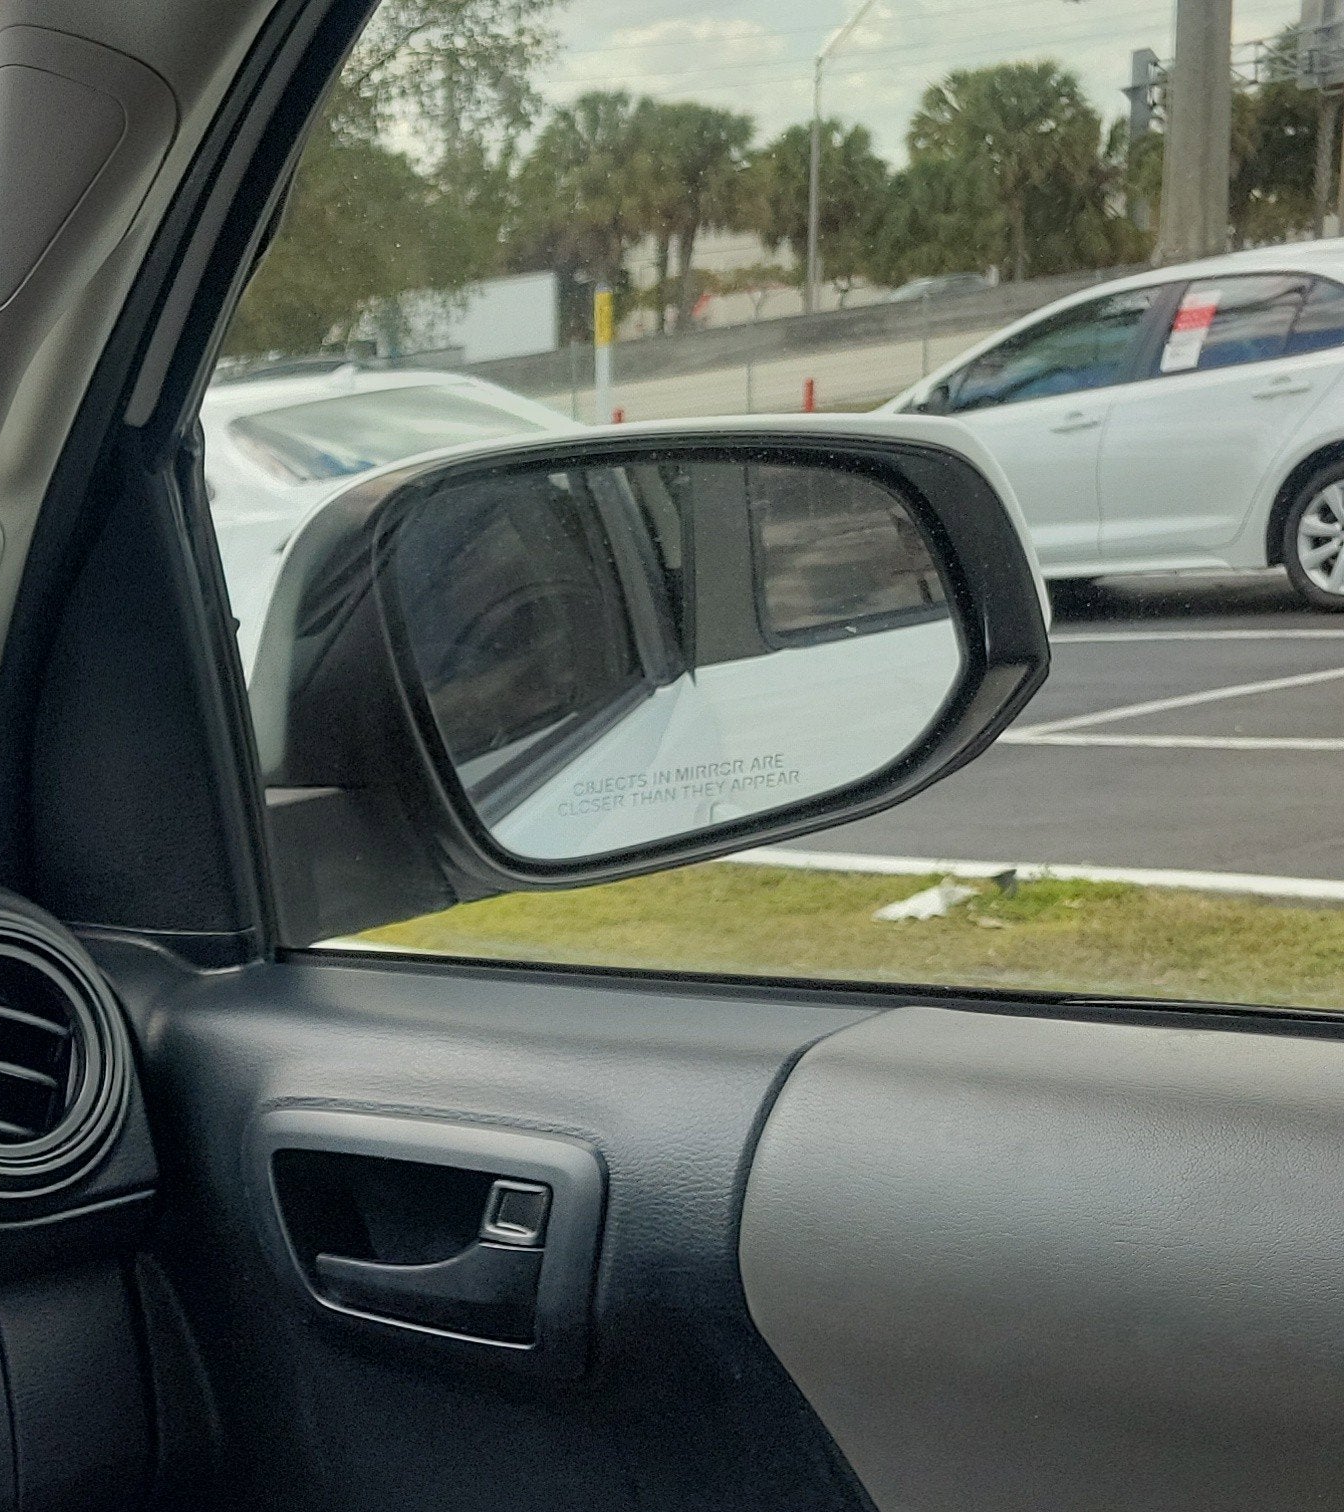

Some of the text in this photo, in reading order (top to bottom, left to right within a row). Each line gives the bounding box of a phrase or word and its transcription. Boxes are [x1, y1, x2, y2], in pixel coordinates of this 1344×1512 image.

[653, 770, 671, 785] IN
[750, 754, 785, 774] ARE
[632, 788, 676, 807] THAN
[682, 779, 726, 798] THEY
[731, 770, 801, 792] APPEAR
